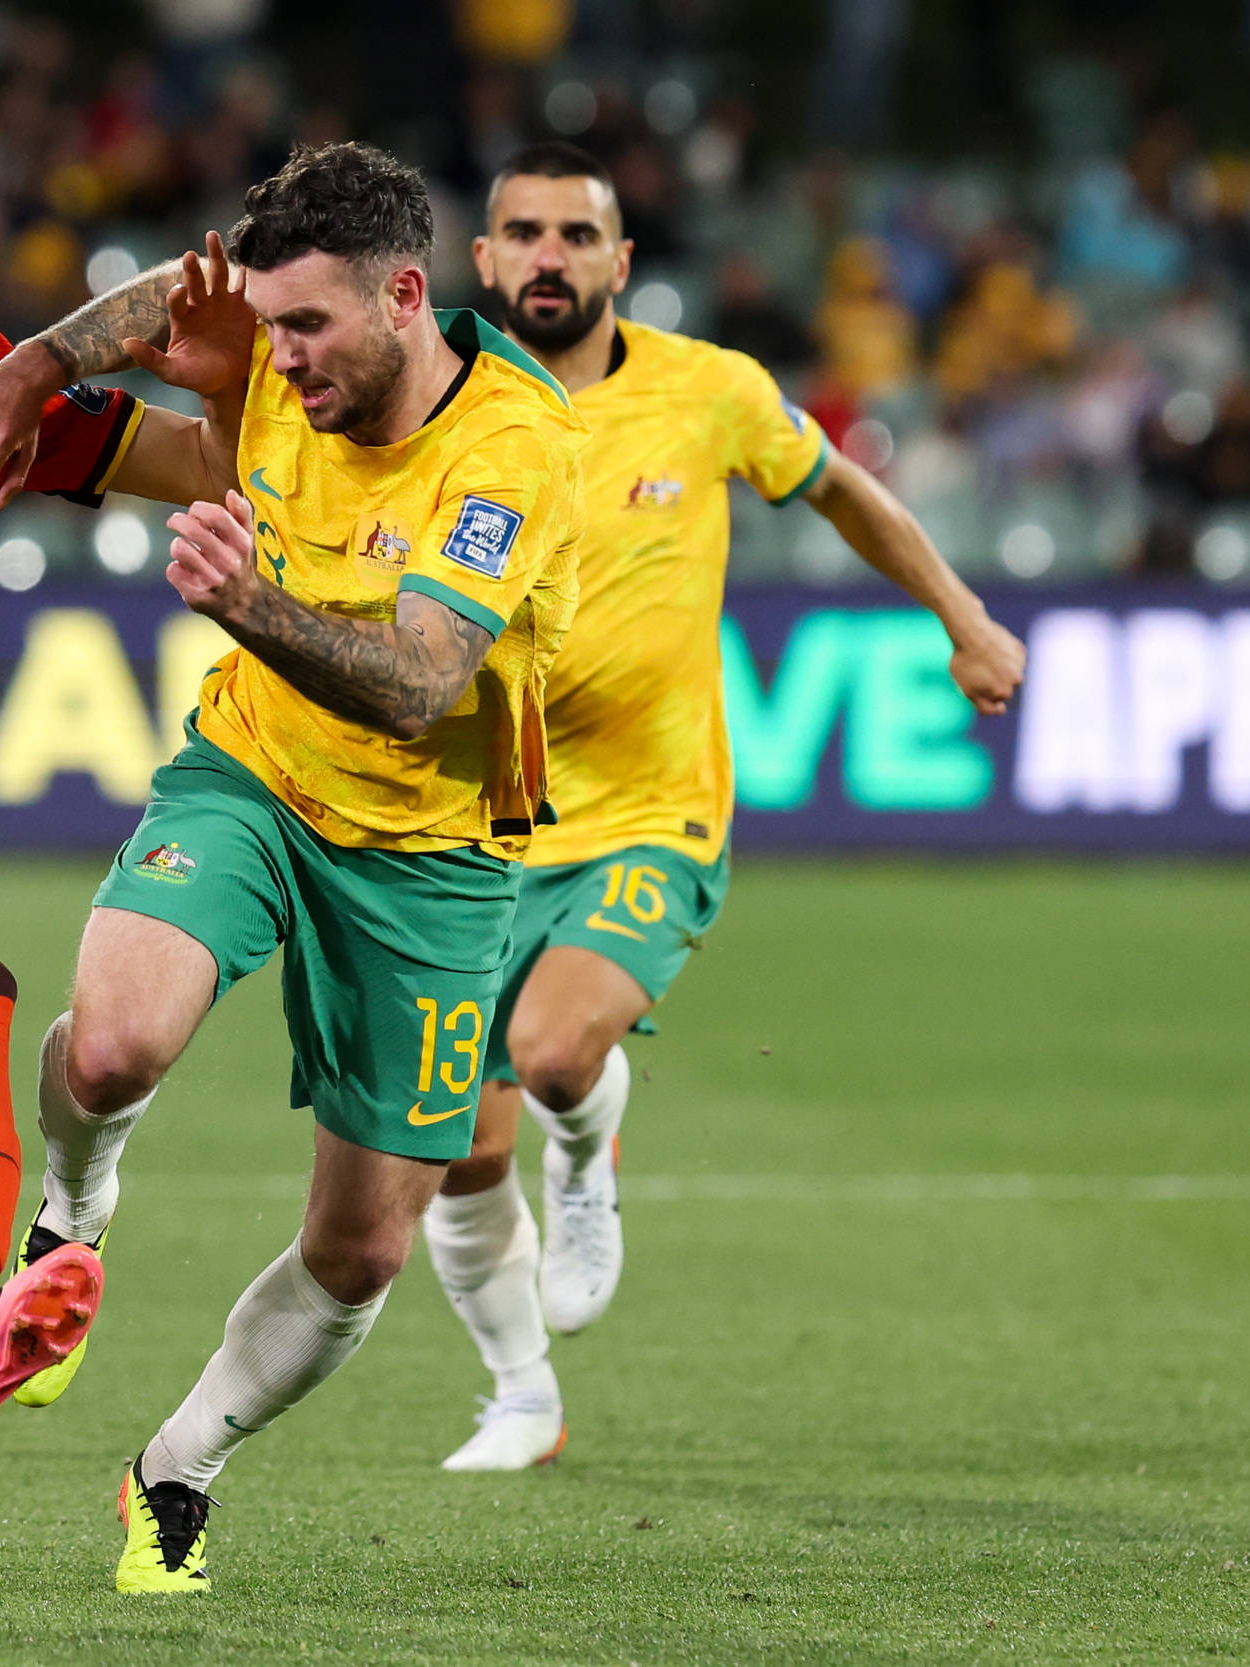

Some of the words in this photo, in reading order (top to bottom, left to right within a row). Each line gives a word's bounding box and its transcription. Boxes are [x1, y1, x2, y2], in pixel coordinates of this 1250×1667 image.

[470, 520, 505, 543] UNITES
[473, 509, 509, 531] FOOTBALL
[600, 862, 669, 924] 16
[416, 996, 483, 1095] 13
